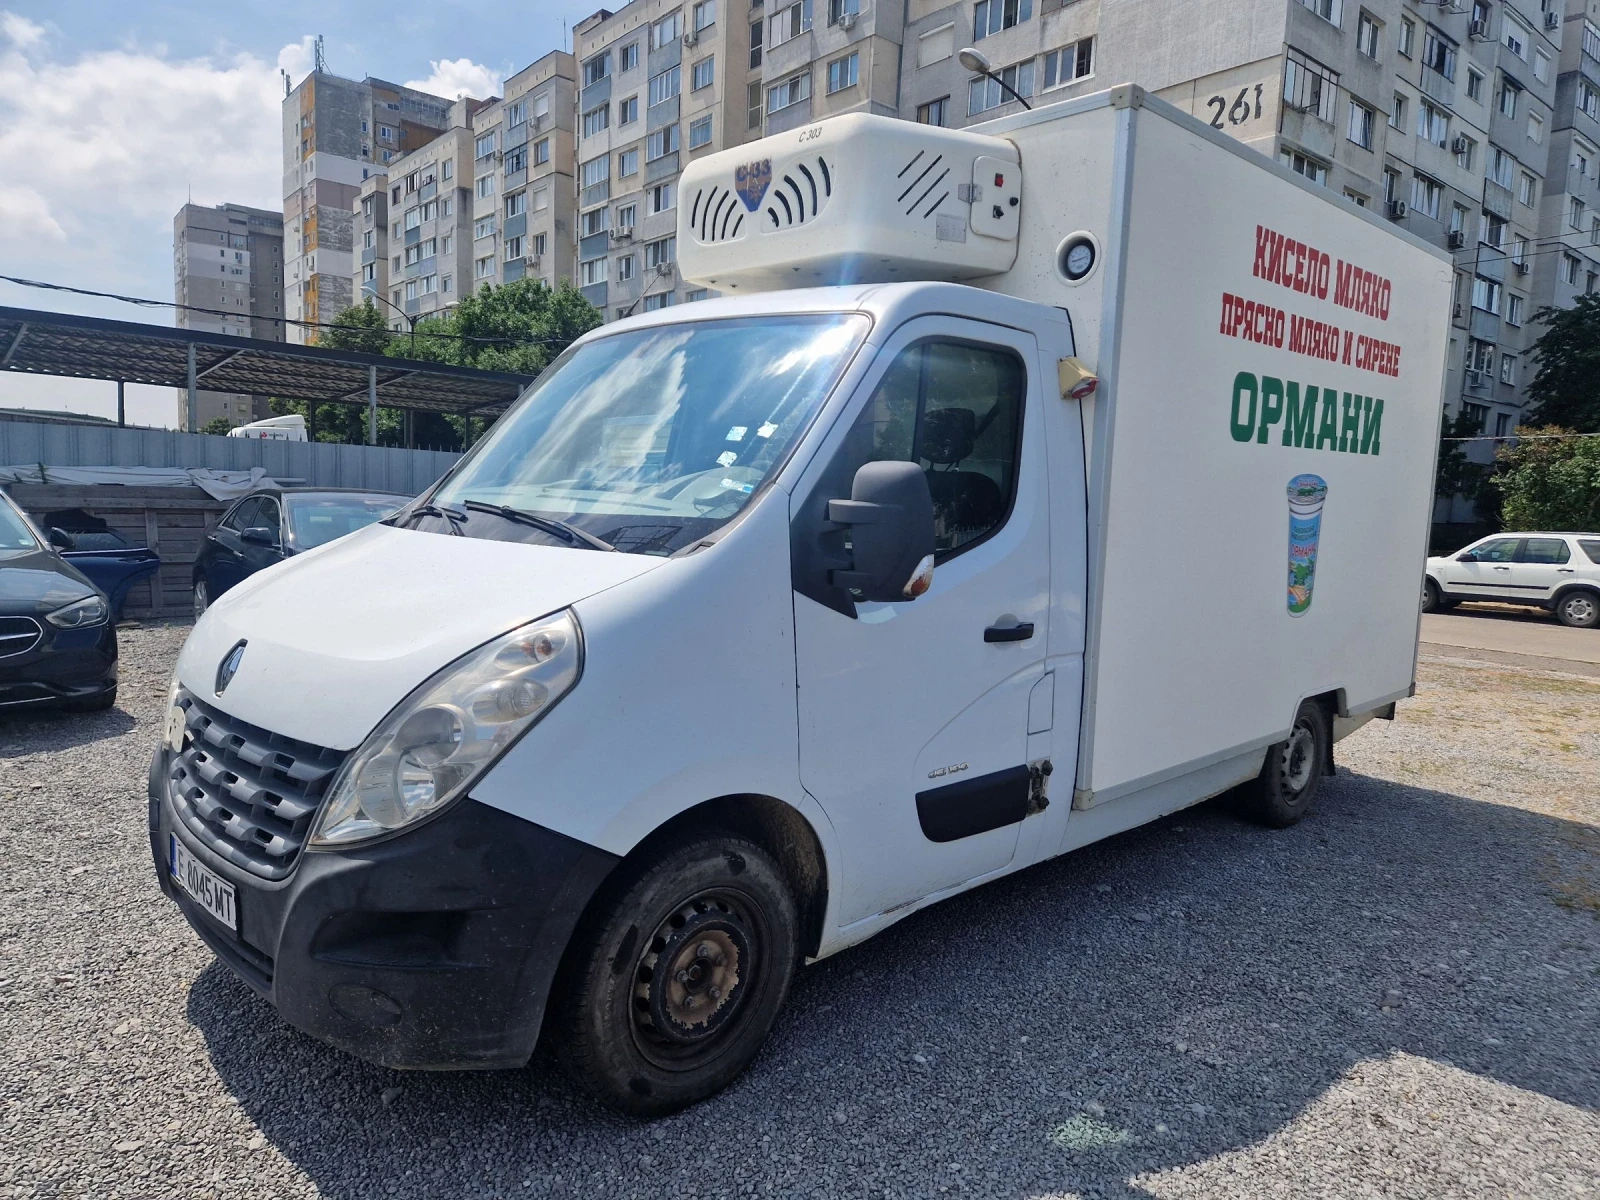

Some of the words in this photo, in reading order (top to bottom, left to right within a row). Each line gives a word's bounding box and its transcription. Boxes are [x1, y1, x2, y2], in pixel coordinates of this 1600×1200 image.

[798, 131, 806, 142] C
[806, 127, 822, 140] 303
[1207, 83, 1263, 129] 261
[1253, 225, 1330, 300] КИСЕЛО
[1334, 259, 1391, 321] МЛЯКО
[1220, 292, 1285, 349] ПРЯСНО
[1289, 314, 1340, 362] МЛЯКО
[1342, 330, 1354, 366] И
[1356, 334, 1401, 378] СИРЕНЕ
[1230, 371, 1385, 456] ОРМАНИ
